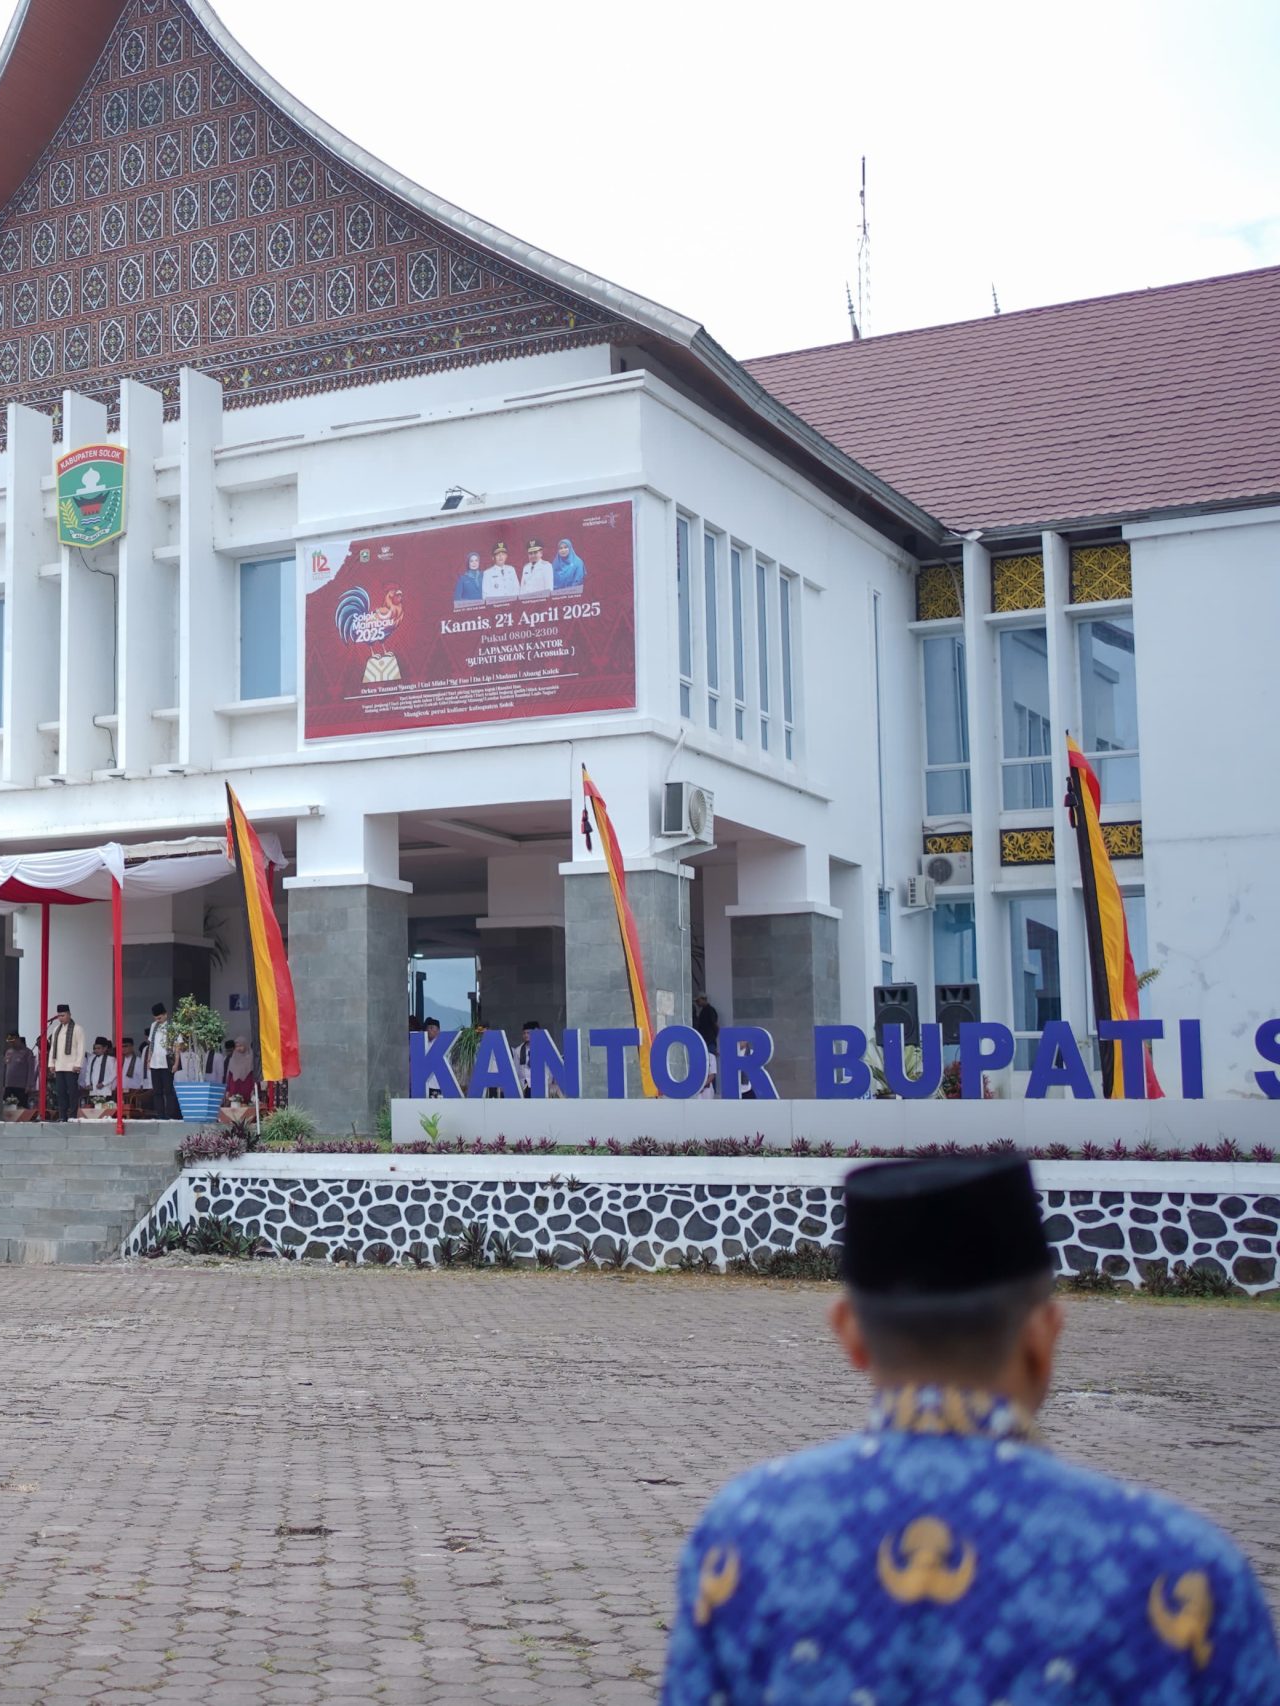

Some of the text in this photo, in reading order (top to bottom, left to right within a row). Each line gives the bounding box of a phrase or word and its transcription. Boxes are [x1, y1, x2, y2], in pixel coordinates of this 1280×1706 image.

[60, 449, 121, 469] KABUPATEN SOLOK
[352, 611, 377, 621] Solok
[495, 613, 514, 628] 24
[518, 606, 559, 627] April
[562, 602, 601, 620] 2025
[352, 618, 394, 631] Maimbau
[355, 627, 385, 643] 2025
[481, 632, 507, 644] Pukul
[478, 639, 563, 656] LAPANGAN KANTOR
[498, 652, 525, 662] SOLOK
[409, 1025, 781, 1099] KANTOR
[814, 1019, 1204, 1099] BUPATI
